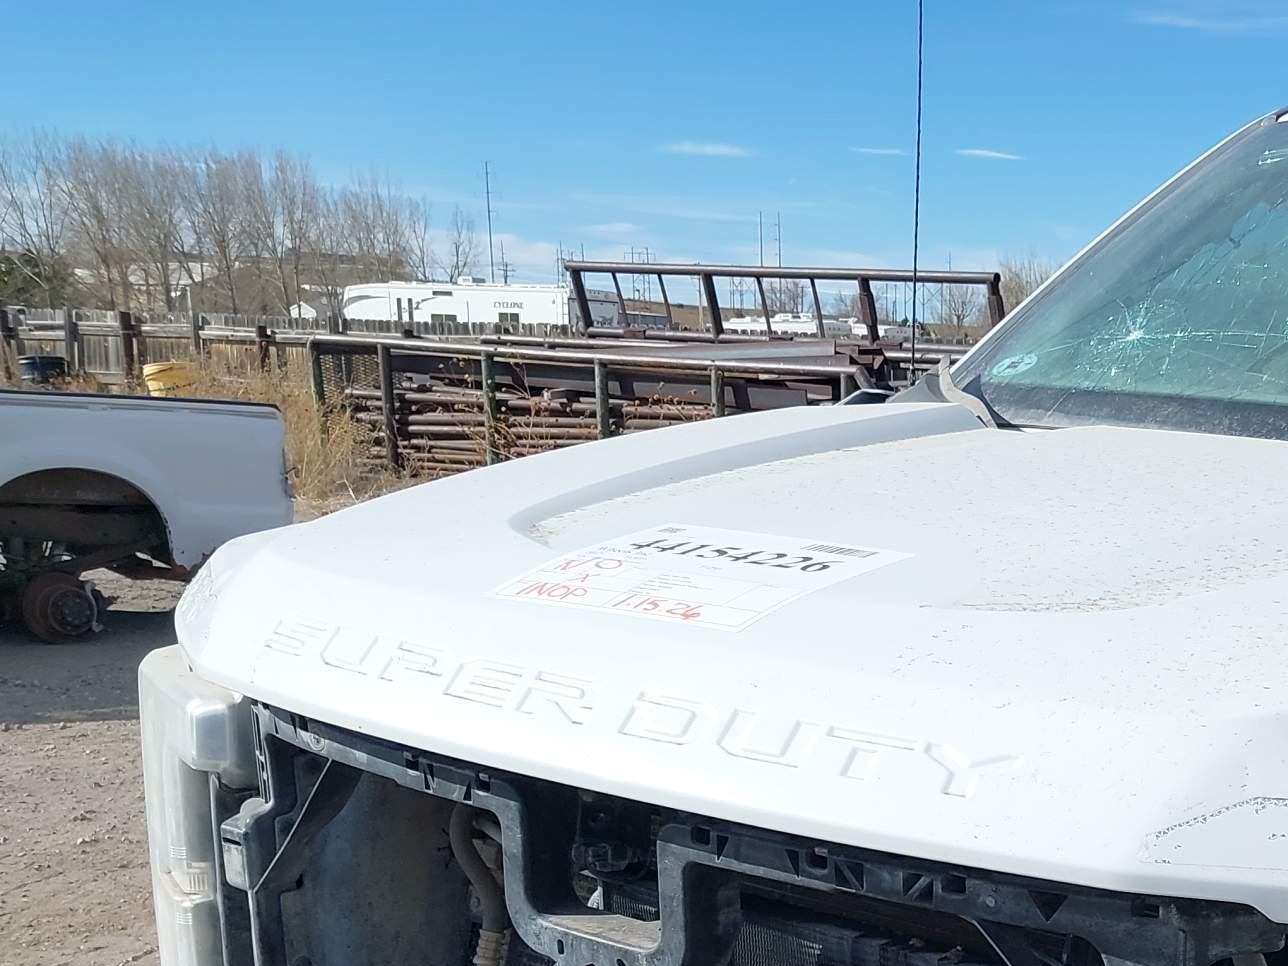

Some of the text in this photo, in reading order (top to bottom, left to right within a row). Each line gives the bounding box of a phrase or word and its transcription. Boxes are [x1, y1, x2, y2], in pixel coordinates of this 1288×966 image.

[493, 301, 524, 310] CYCLONE
[630, 538, 845, 573] 44154226
[515, 581, 588, 600] INOP
[263, 616, 1023, 798] SUPER DUTY
